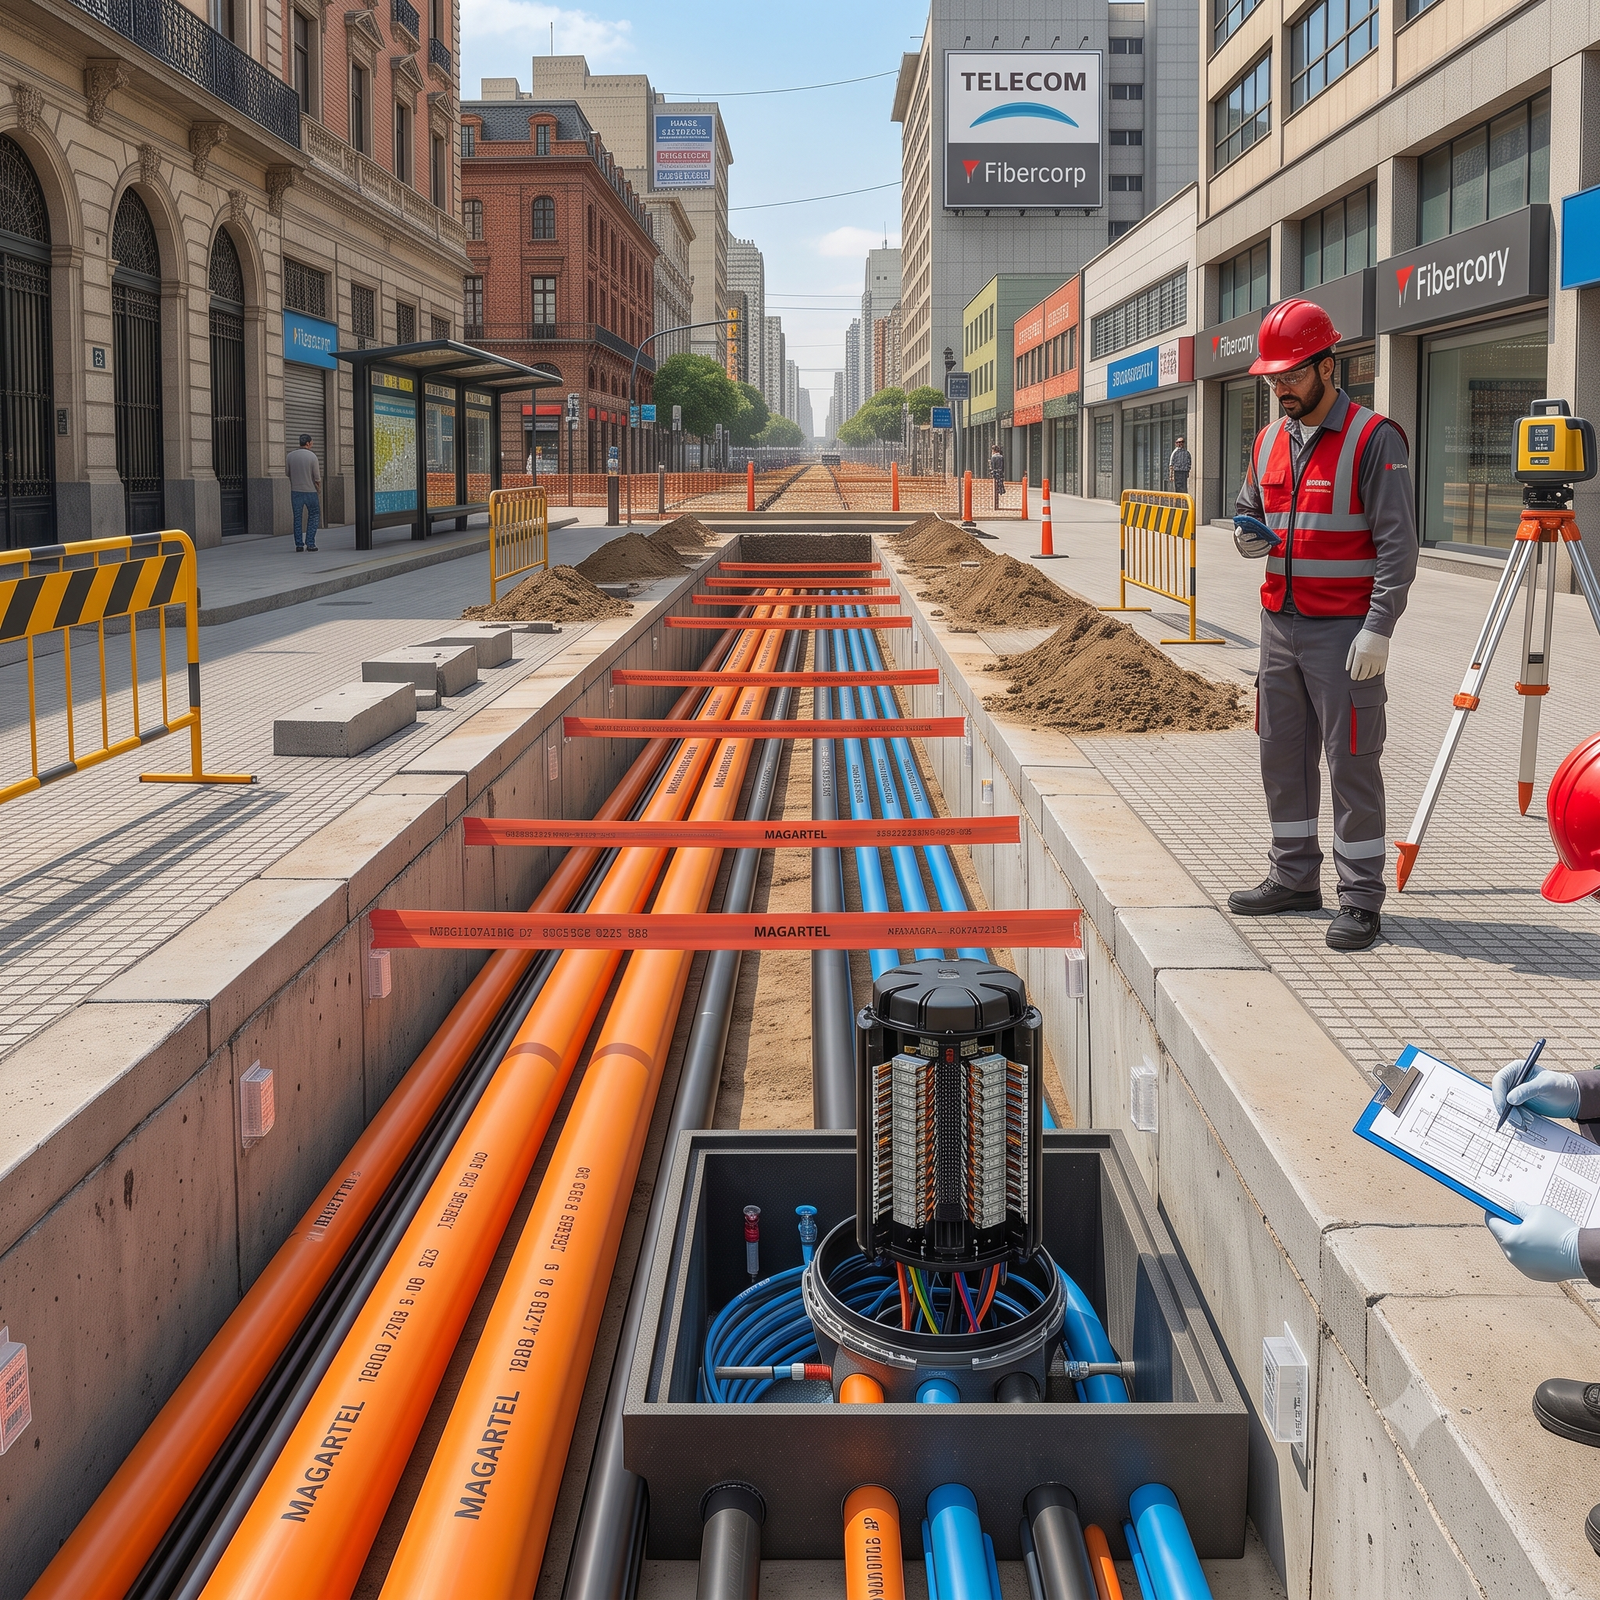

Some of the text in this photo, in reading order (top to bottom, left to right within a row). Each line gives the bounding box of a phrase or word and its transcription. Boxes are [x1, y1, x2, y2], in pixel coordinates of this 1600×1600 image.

[960, 72, 1087, 92] TELECOM
[985, 162, 1086, 188] Fibercorp
[1416, 247, 1510, 300] Fibercory
[1219, 333, 1255, 358] Fibercory
[764, 830, 828, 839] MAGARTEL
[754, 926, 831, 938] MAGARTEL
[281, 1401, 366, 1523] MAGARTEL
[454, 1390, 521, 1520] MAGARTEL
